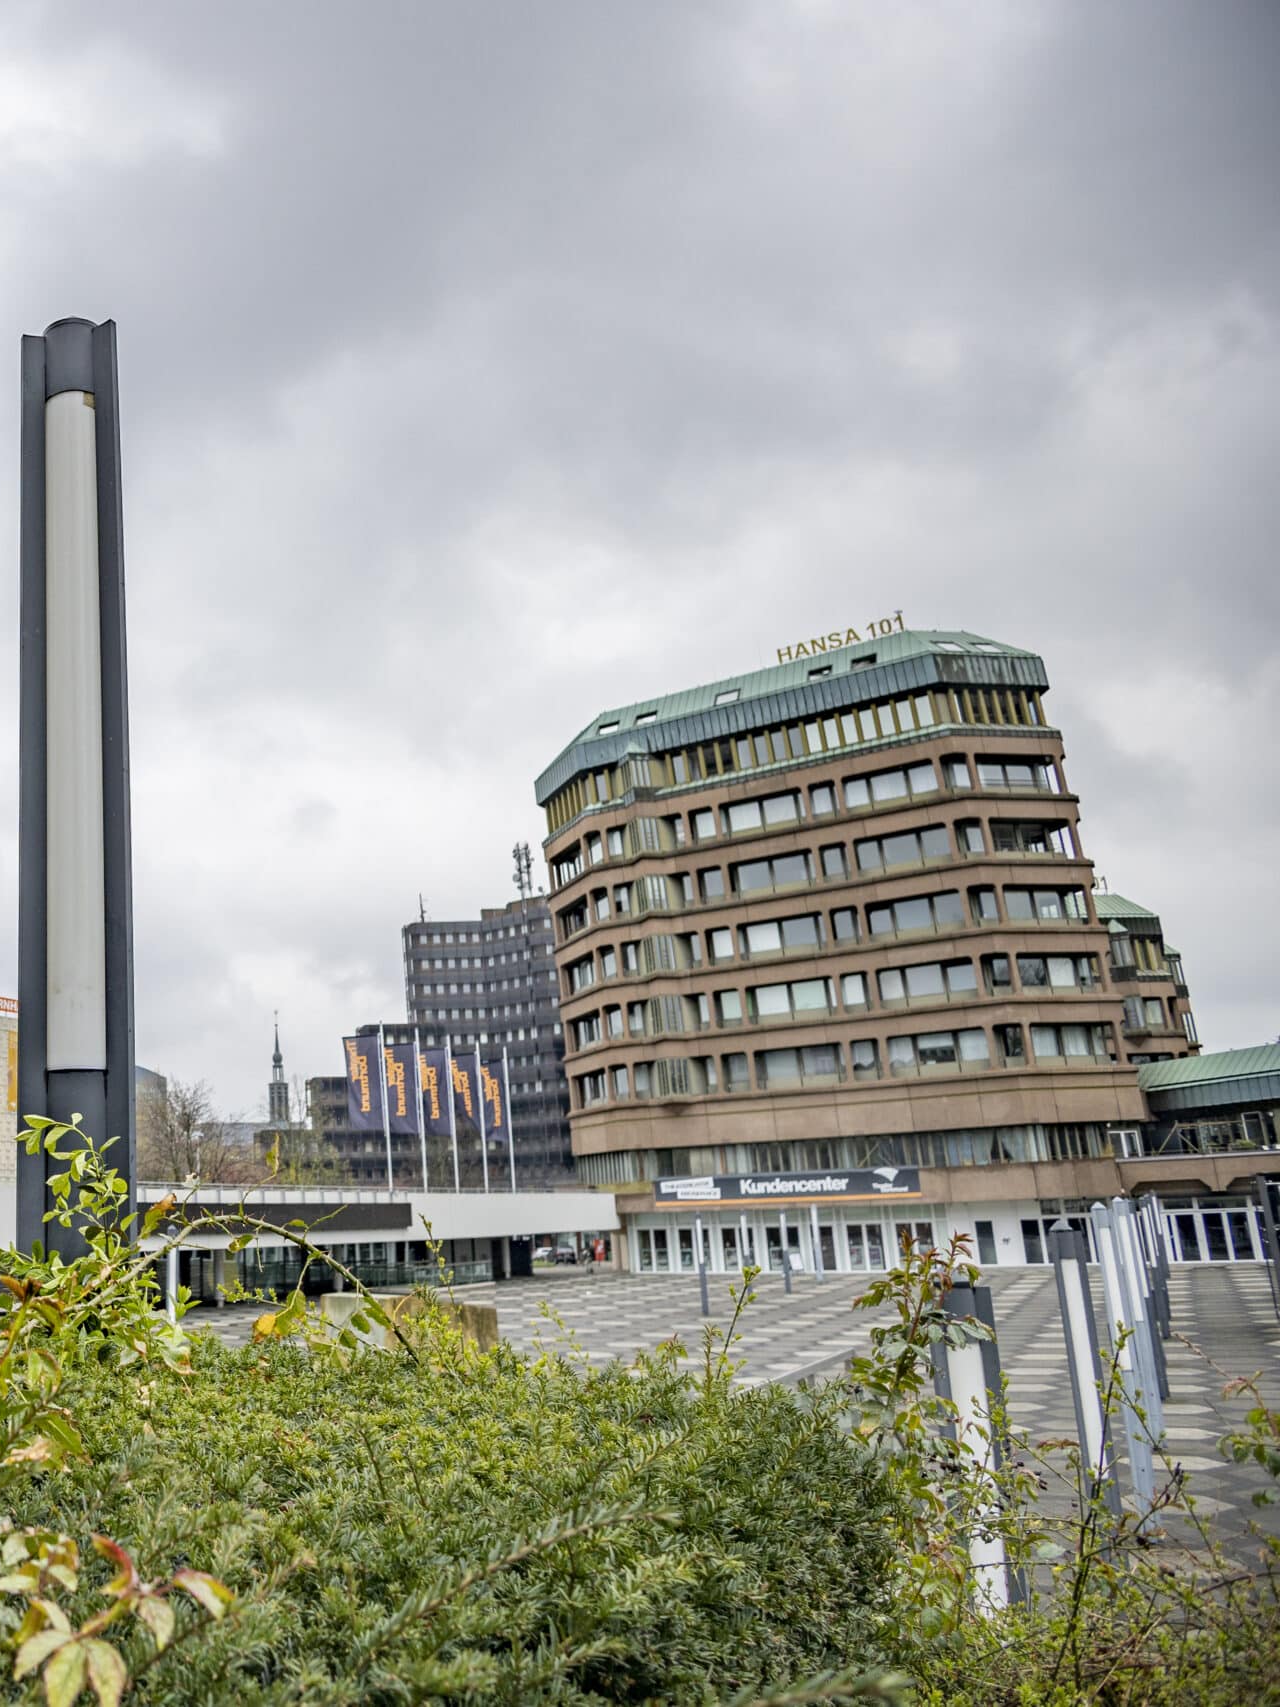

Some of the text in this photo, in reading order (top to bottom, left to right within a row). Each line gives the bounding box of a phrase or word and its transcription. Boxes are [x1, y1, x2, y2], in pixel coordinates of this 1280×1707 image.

[776, 614, 905, 664] HANSA 101
[740, 1176, 849, 1195] Kundencenter
